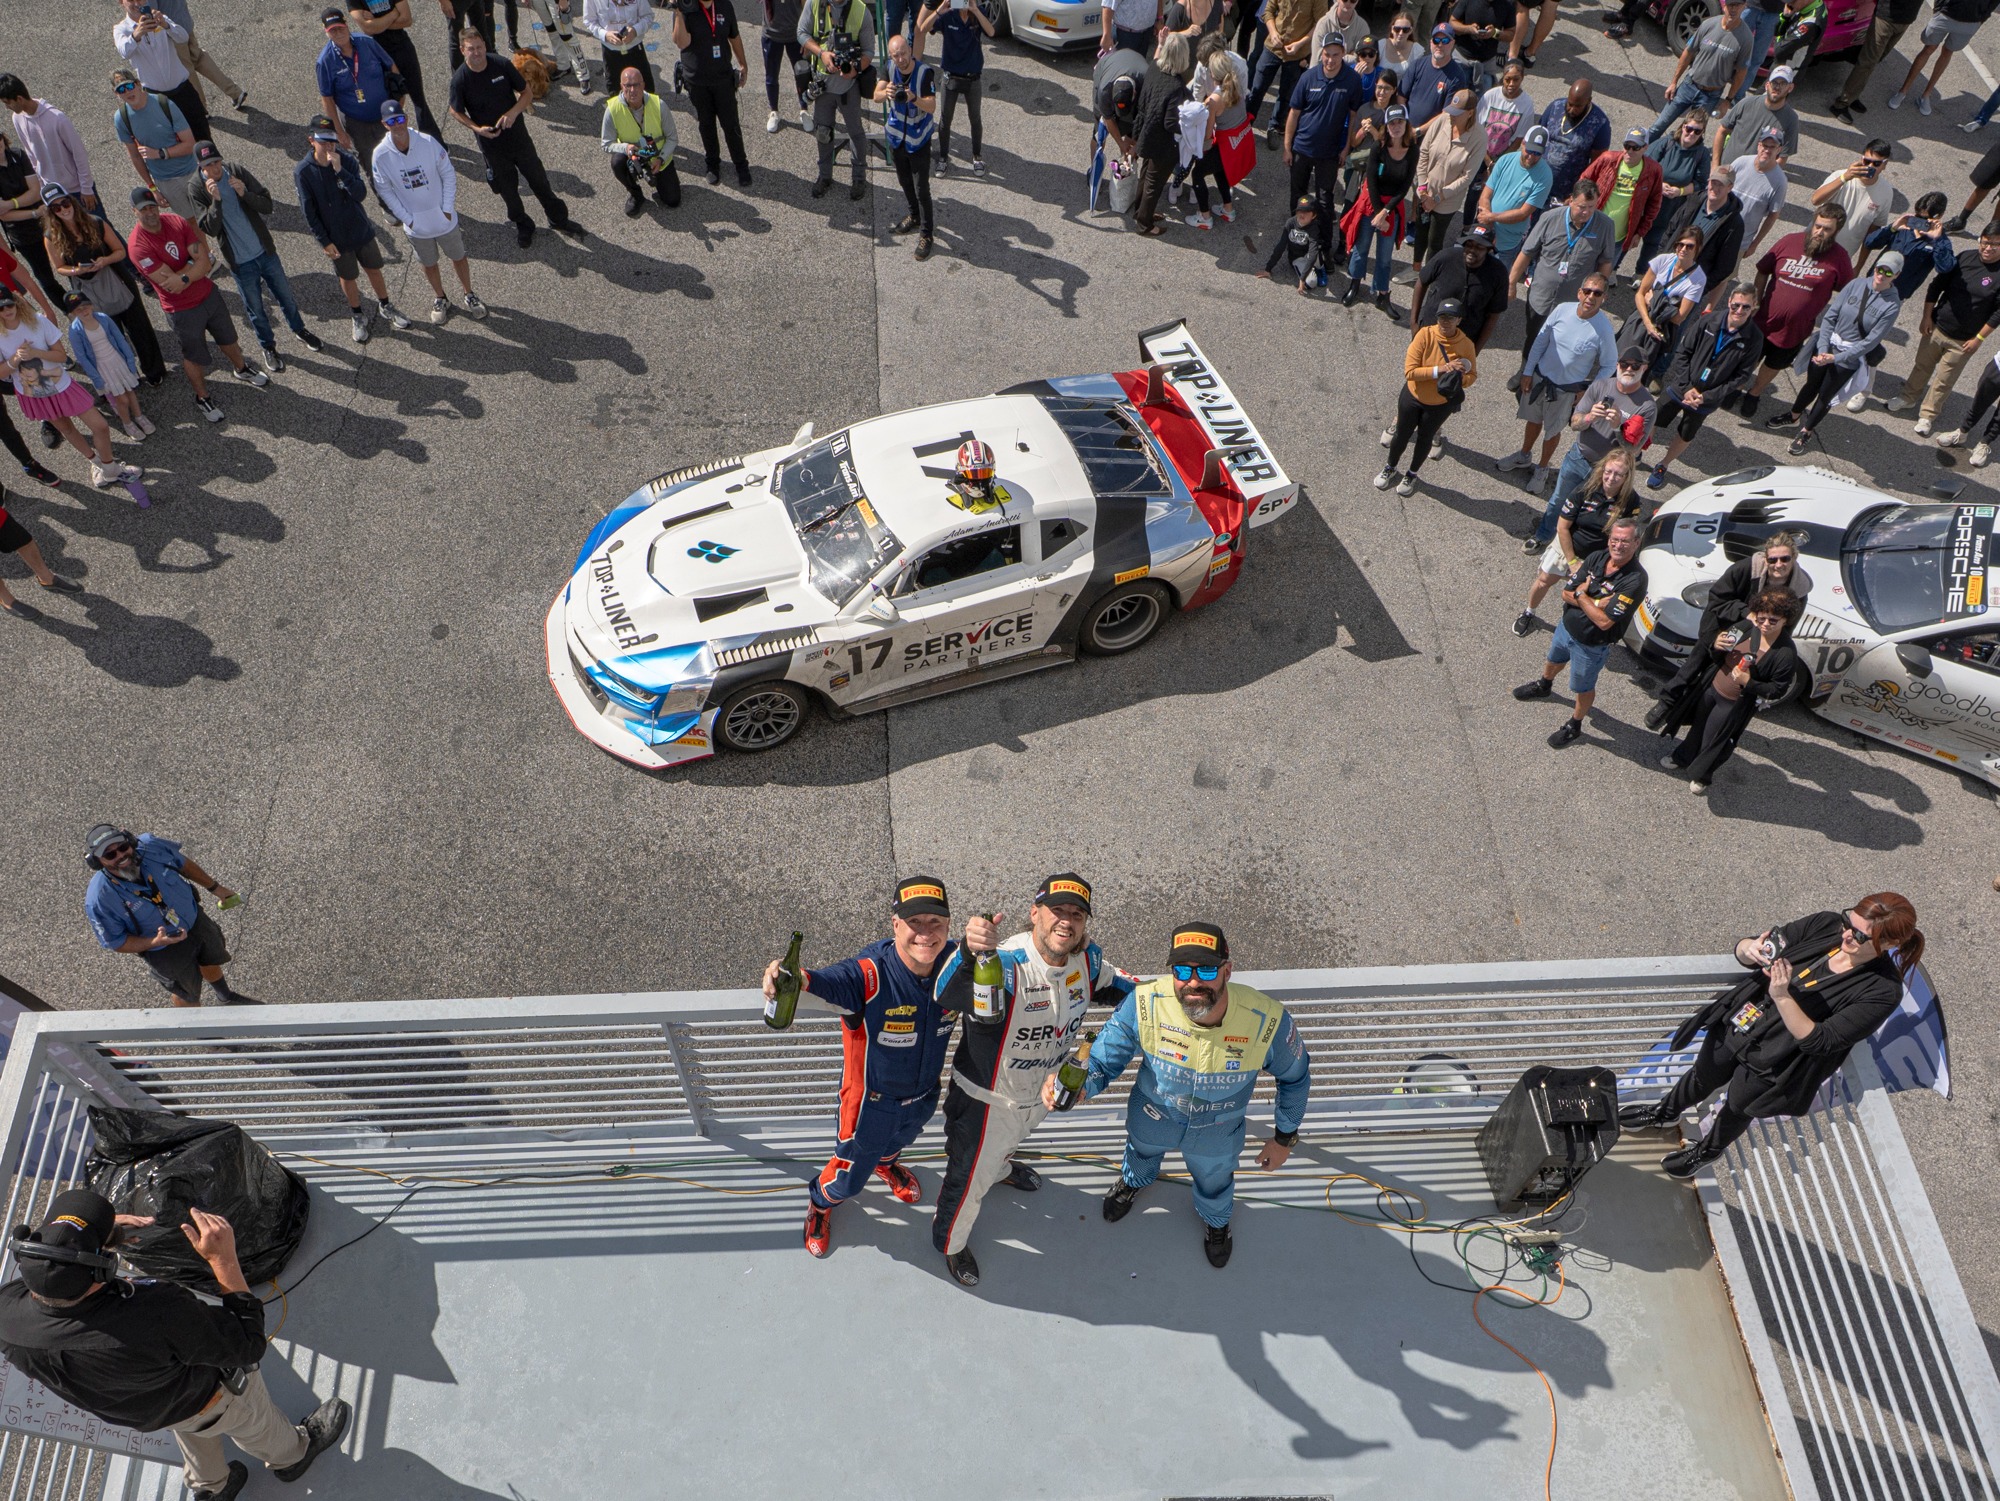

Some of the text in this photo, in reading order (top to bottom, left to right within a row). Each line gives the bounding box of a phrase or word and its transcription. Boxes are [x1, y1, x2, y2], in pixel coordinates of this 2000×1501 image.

[1084, 14, 1101, 25] SGT
[1780, 259, 1825, 279] Pepper
[1796, 255, 1818, 267] Dr
[831, 436, 847, 454] TA
[1200, 404, 1277, 483] LINER
[839, 460, 859, 499] Trans Am
[858, 501, 876, 526] PIRELLI
[942, 513, 1021, 541] Adam Andretti
[1693, 519, 1718, 535] 10
[879, 536, 894, 550] 17
[1947, 507, 1975, 612] PORSCHE
[1970, 535, 1986, 576] Trans Am 10
[1116, 567, 1148, 583] PIRELLI
[1968, 577, 1981, 603] PIRELLI
[591, 553, 641, 649] TOP LINER
[904, 613, 1033, 661] SERVICE
[1821, 637, 1847, 645] Trans
[848, 637, 893, 675] 17
[904, 633, 1032, 673] PARTNERS
[1815, 647, 1854, 674] 10
[1933, 706, 1972, 722] COFFEE
[903, 888, 941, 899] PIRELLI
[1053, 882, 1089, 899] PIRELLI
[1176, 935, 1214, 948] PIRELLI
[1015, 1012, 1086, 1041] SERVICE
[1161, 1036, 1189, 1050] Trans Am
[1008, 1049, 1070, 1069] TOP LINE
[1152, 1058, 1248, 1084] PITTSBURGH
[1164, 1074, 1190, 1085] PAINTS
[1152, 1088, 1236, 1113] PREMIER
[86, 1421, 96, 1441] XGT
